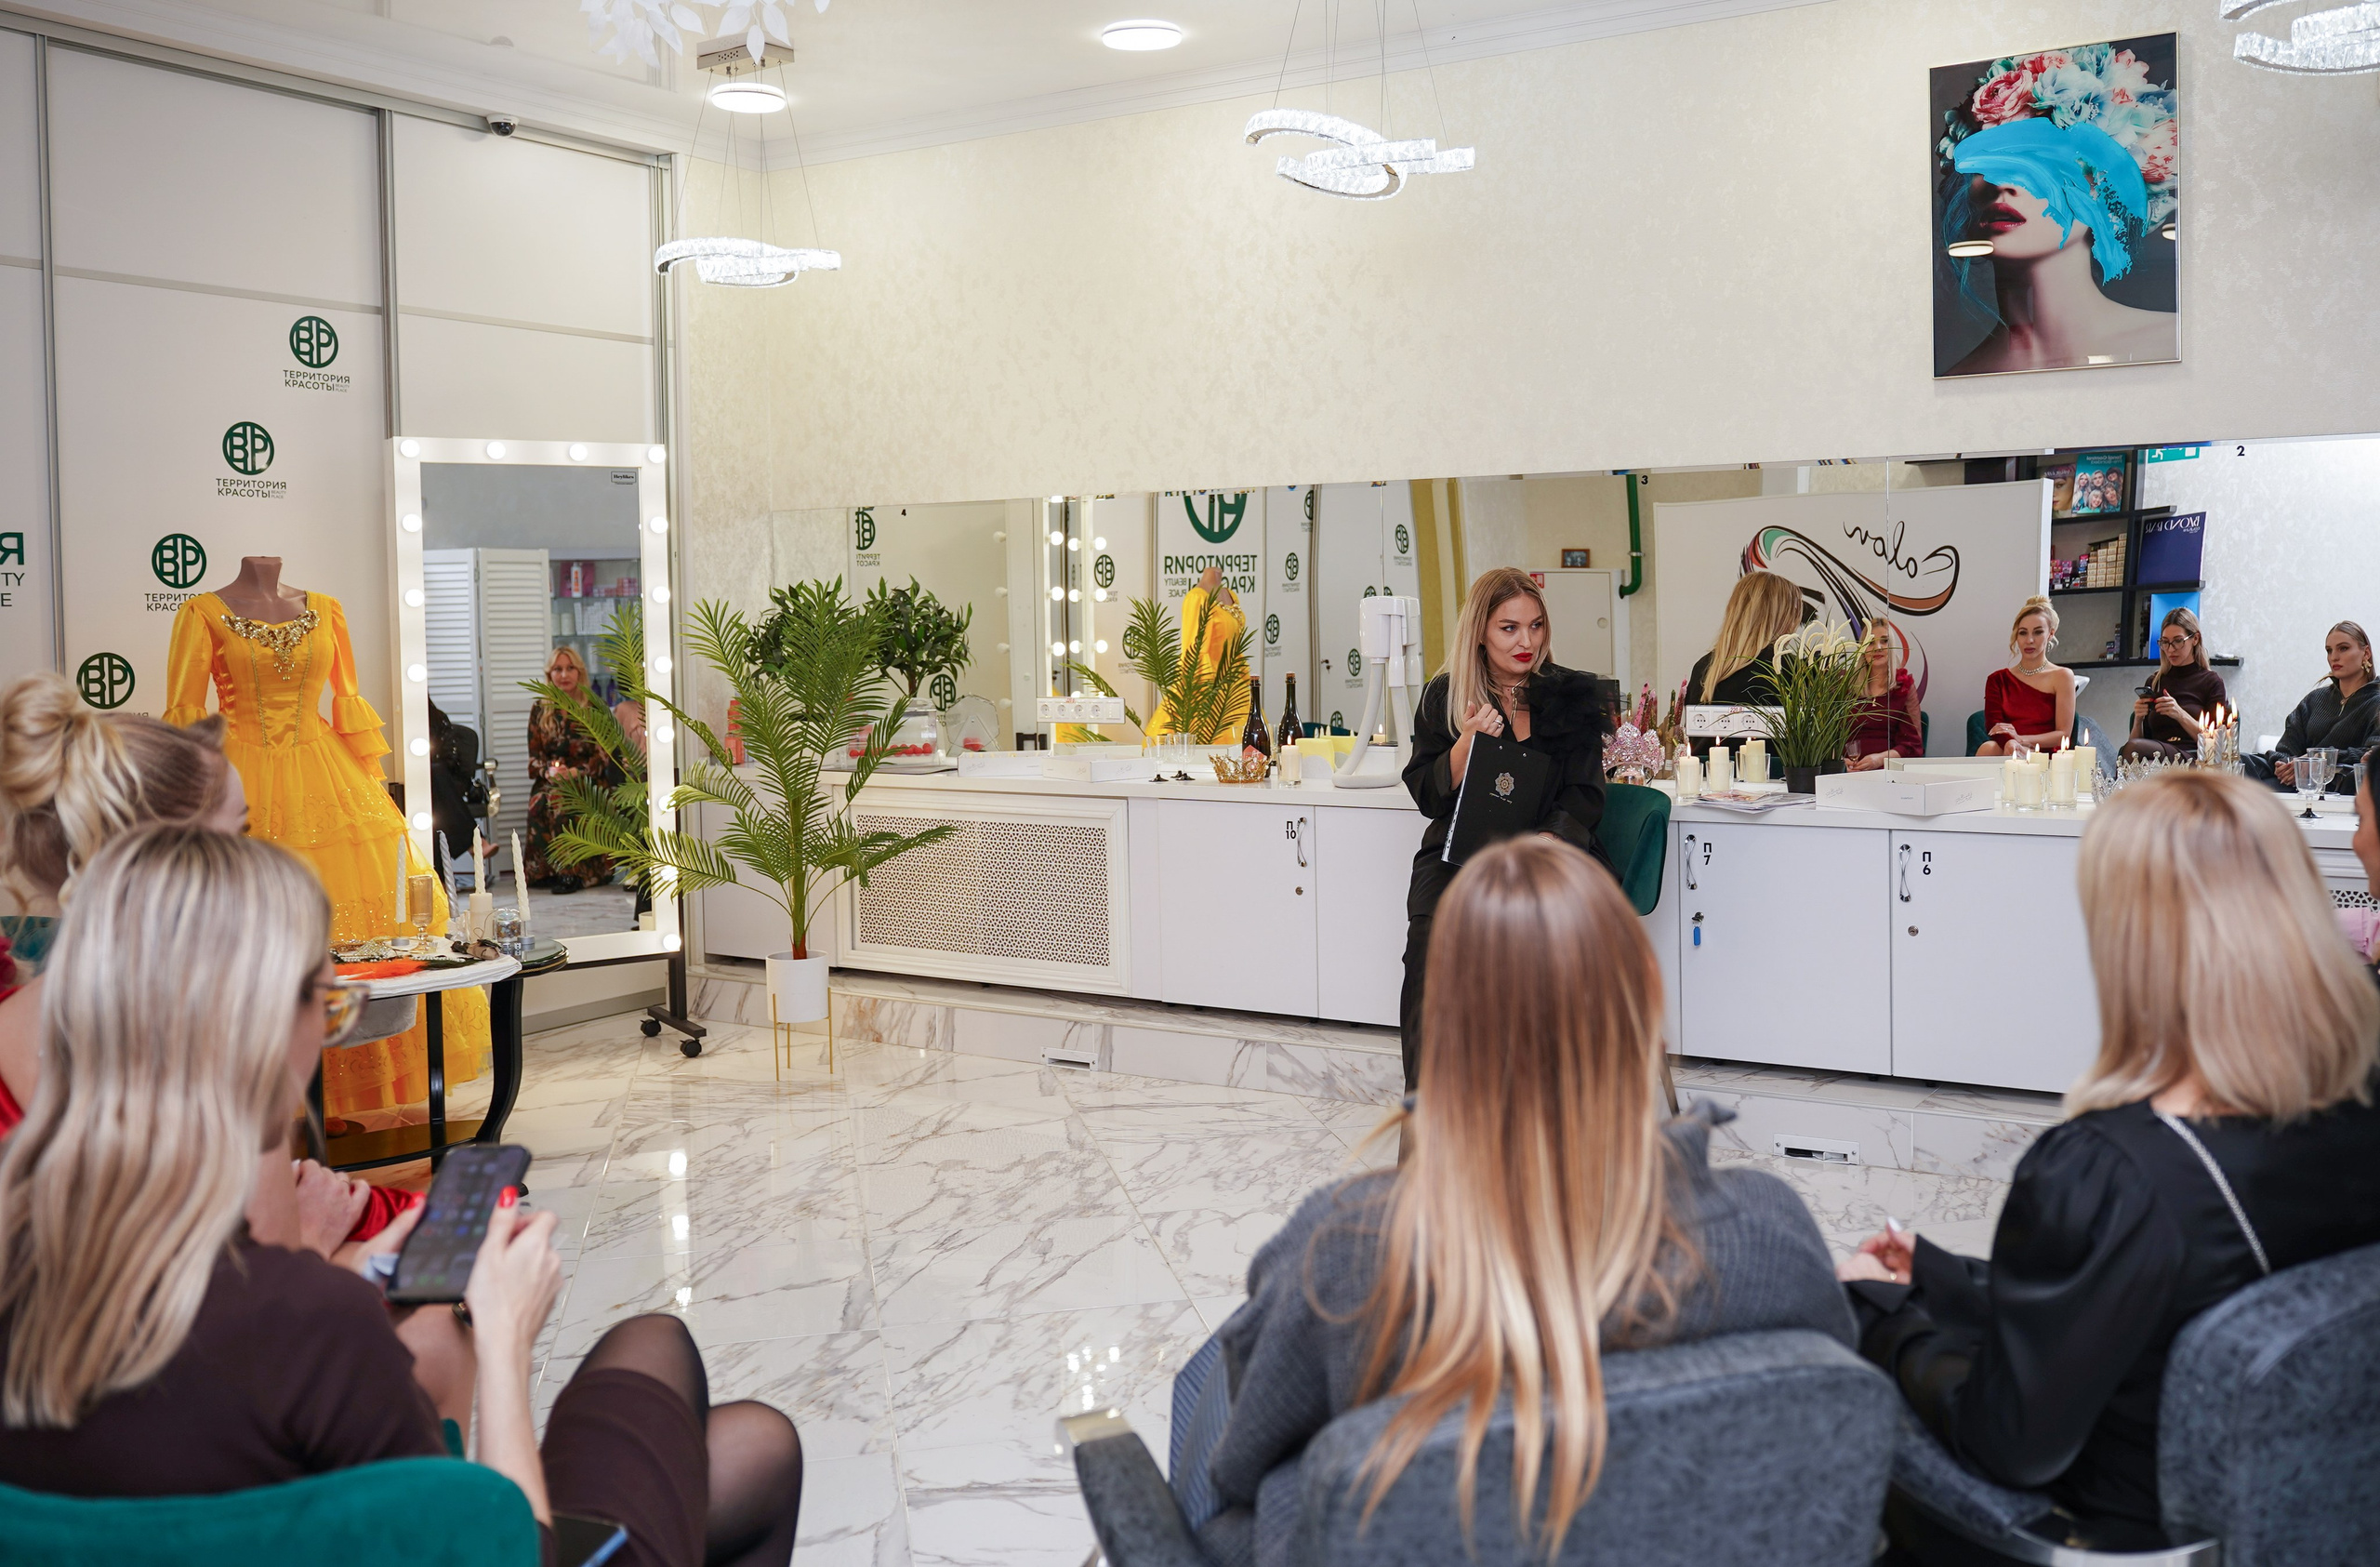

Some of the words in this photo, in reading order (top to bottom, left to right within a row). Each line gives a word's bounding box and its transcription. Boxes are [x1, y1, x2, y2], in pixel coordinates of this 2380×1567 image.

[283, 370, 350, 384] ТЕРРИТОРИЯ
[284, 379, 335, 392] КРАСОТЫ
[2236, 445, 2245, 457] 2
[216, 478, 286, 489] ТЕРРИТОРИЯ
[1641, 474, 1648, 485] 3
[218, 487, 271, 498] КРАСОТЫ
[1287, 820, 1293, 830] П
[1286, 830, 1296, 840] 10
[1703, 843, 1712, 853] П
[1703, 855, 1711, 866] 7
[1923, 852, 1932, 863] П
[1923, 865, 1932, 875] 6
